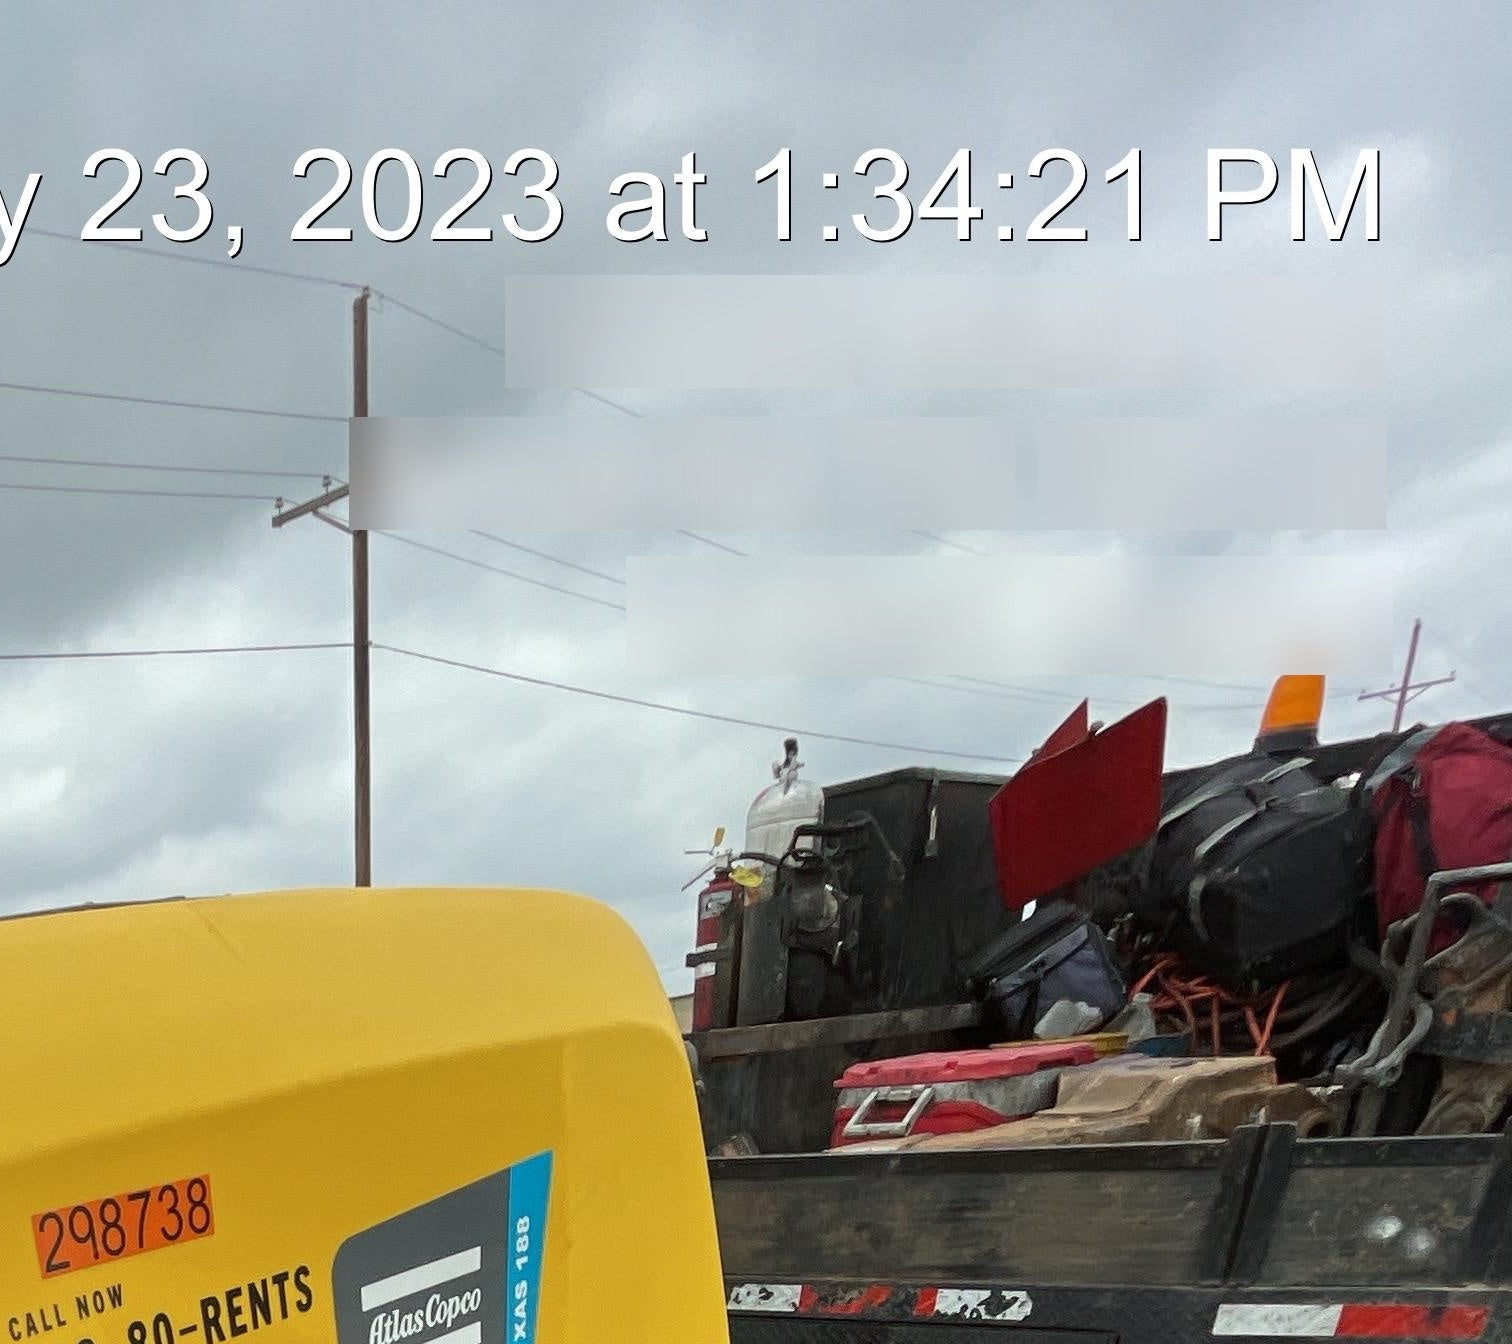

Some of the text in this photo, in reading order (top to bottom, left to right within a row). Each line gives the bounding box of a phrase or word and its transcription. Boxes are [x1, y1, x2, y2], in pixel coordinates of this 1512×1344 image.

[38, 1177, 211, 1273] 298738
[8, 1282, 124, 1342] CALL NOW
[513, 1279, 529, 1343] XAS
